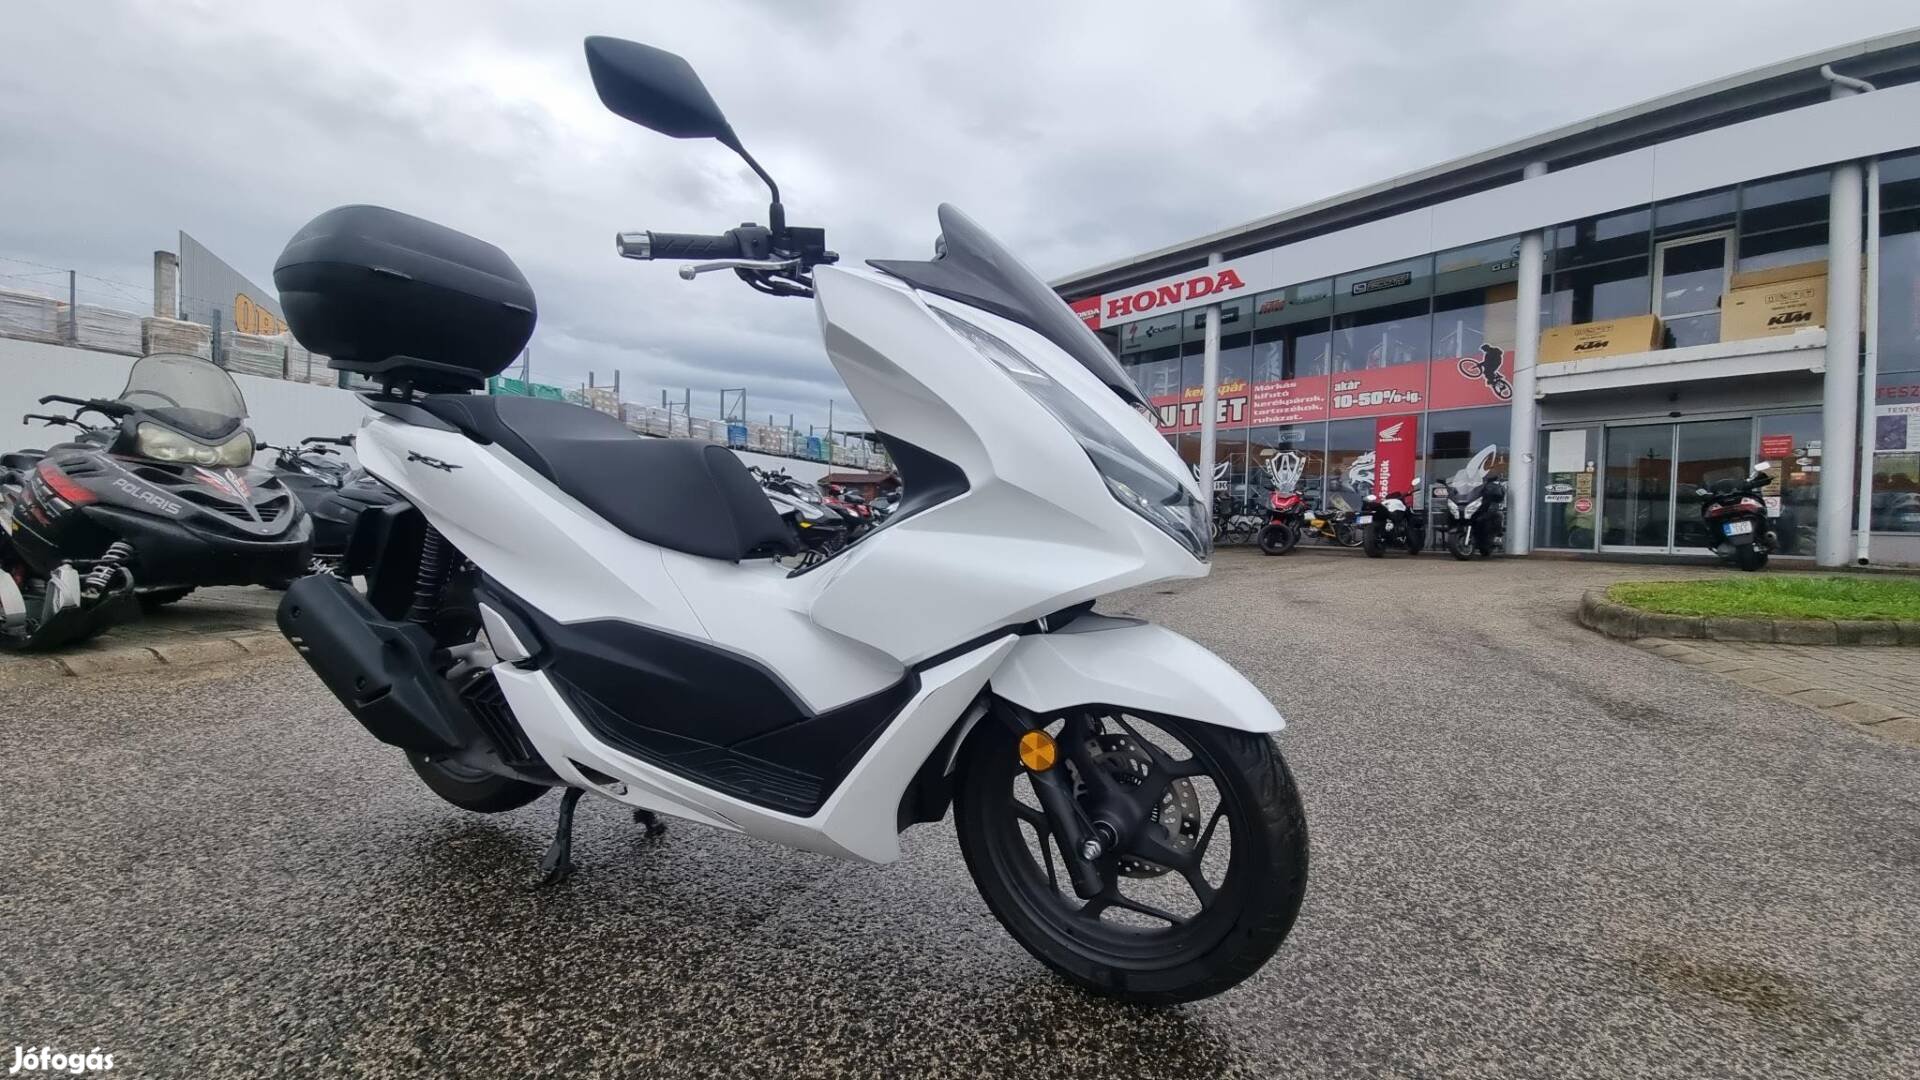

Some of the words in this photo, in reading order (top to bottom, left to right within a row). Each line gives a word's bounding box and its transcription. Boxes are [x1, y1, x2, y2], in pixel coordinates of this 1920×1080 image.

[1107, 269, 1245, 319] HONDA
[1076, 307, 1100, 320] ONDA
[1766, 311, 1813, 326] KTM
[1334, 381, 1360, 391] akár
[1142, 397, 1248, 428] UTET
[112, 477, 182, 516] POLARIS
